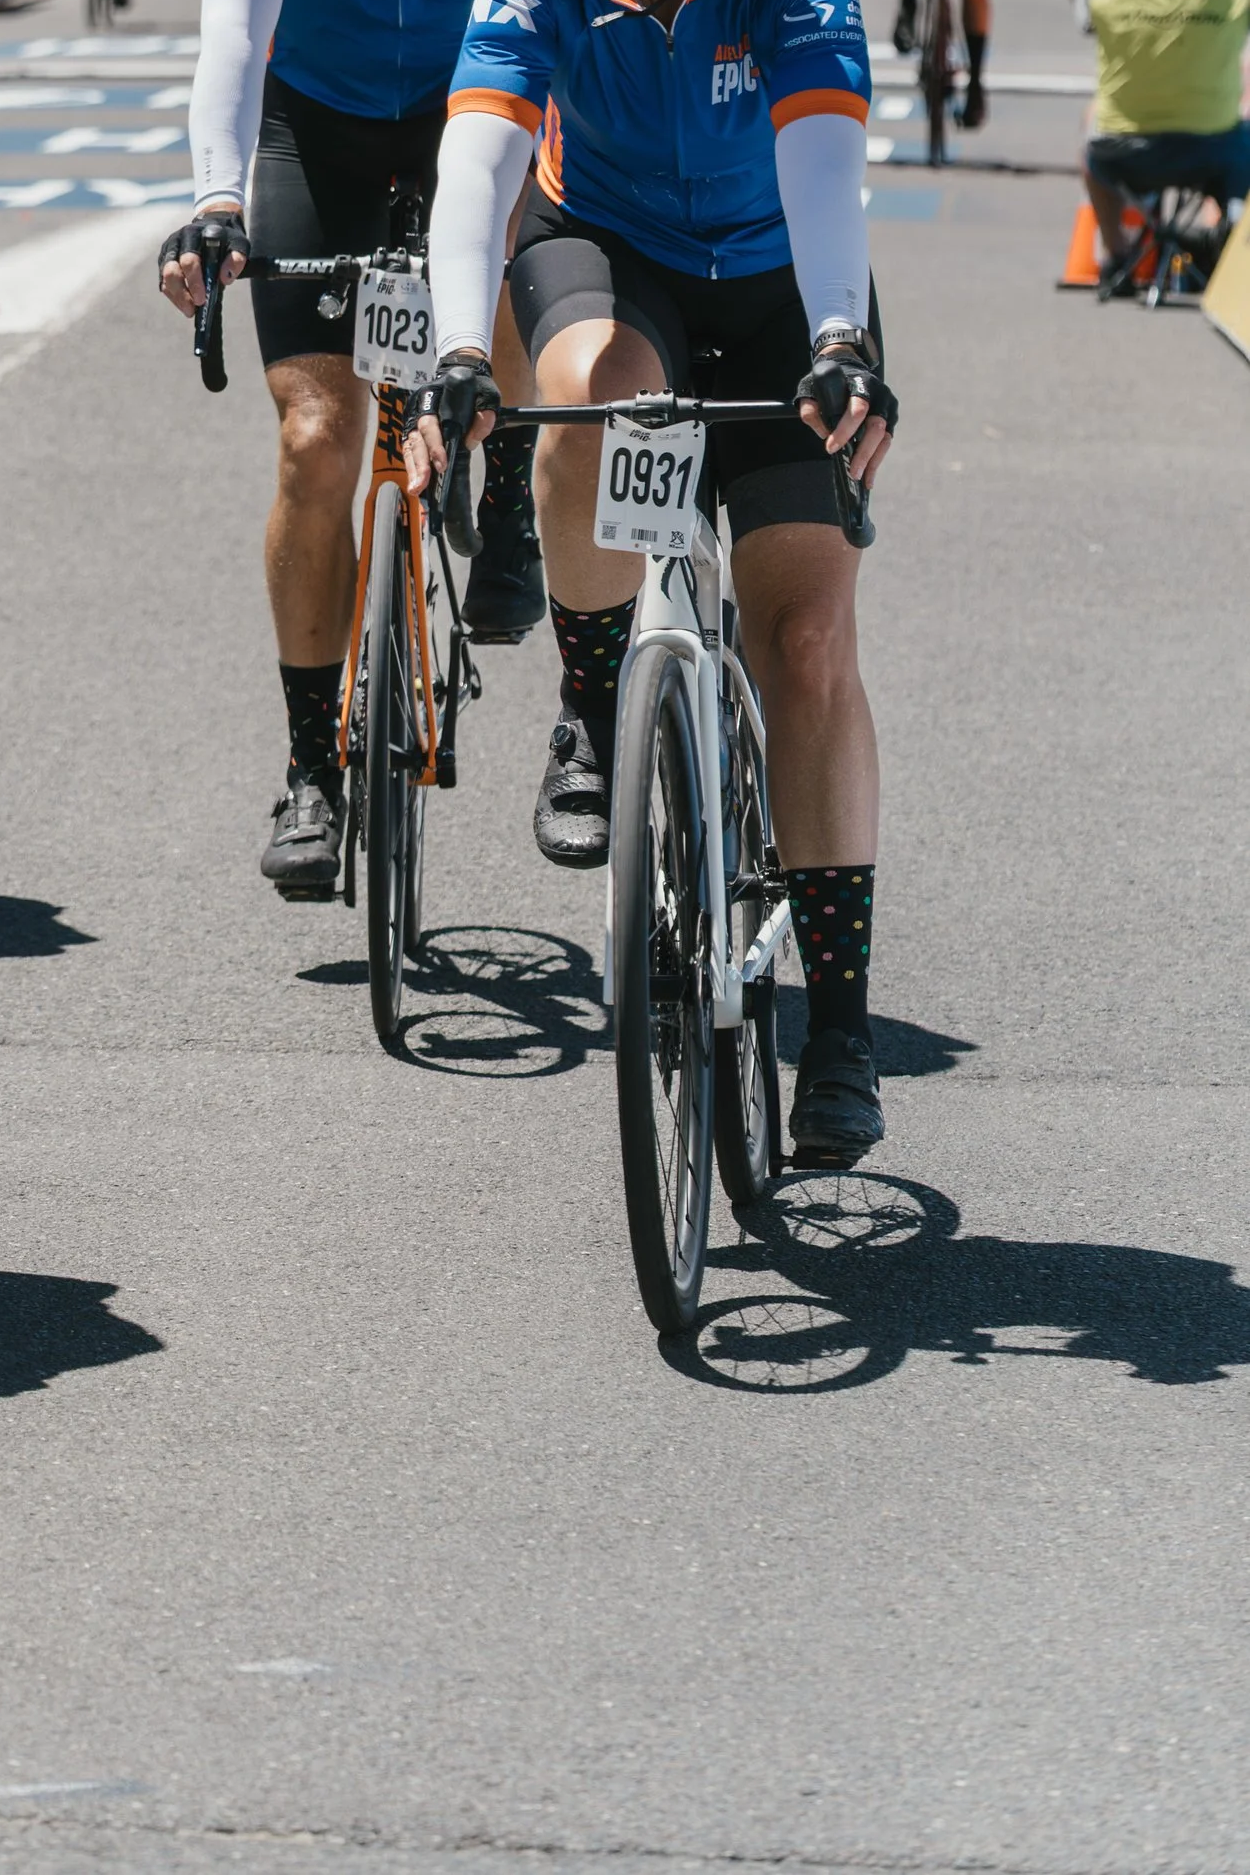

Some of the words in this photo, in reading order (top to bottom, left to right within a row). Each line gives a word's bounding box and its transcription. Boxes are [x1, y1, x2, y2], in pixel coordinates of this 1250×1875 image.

[711, 52, 758, 105] EPIC
[364, 302, 431, 356] 1023
[609, 447, 694, 510] 0931
